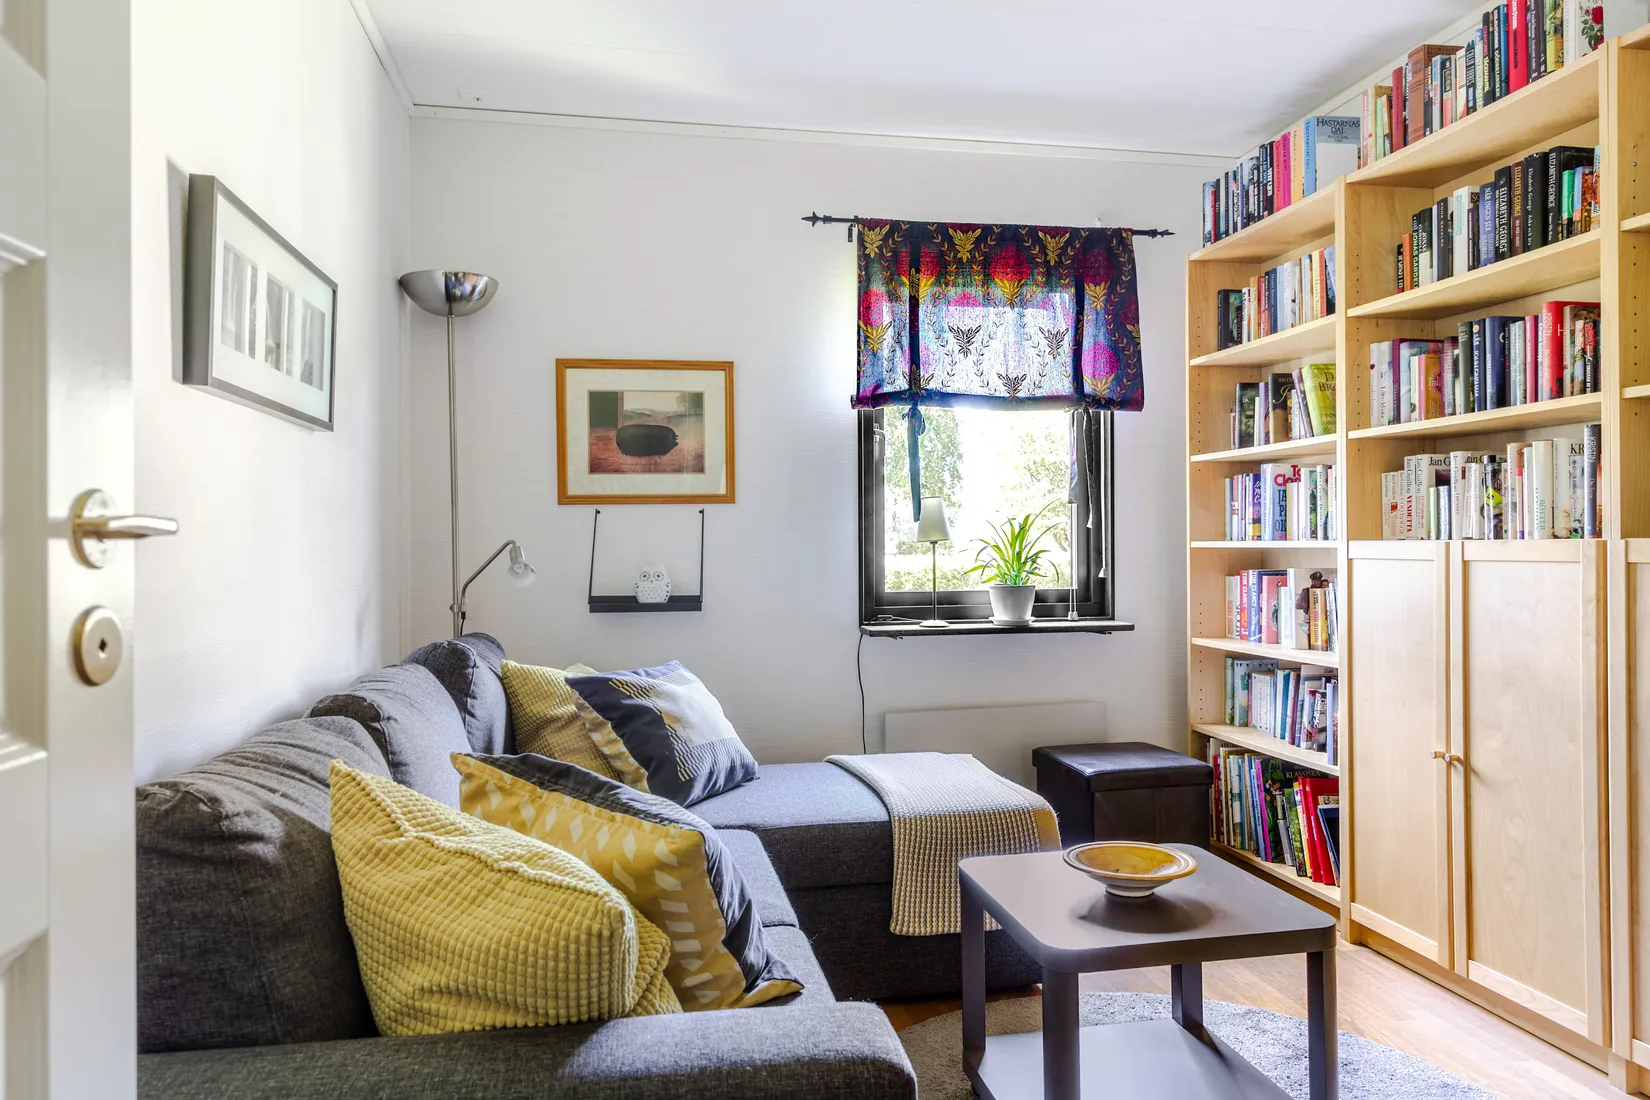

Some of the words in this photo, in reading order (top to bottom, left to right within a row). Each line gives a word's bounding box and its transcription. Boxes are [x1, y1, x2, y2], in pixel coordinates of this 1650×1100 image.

[1514, 166, 1522, 195] ELIZABETH
[1549, 152, 1557, 184] ELIZABETH
[1499, 187, 1508, 224] ELIZABETH
[1548, 185, 1556, 208] GEORGE
[1499, 226, 1508, 253] GEORGE
[1429, 456, 1442, 467] Jan
[1589, 436, 1597, 463] KRISTIN
[1539, 499, 1547, 531] RÖTTER
